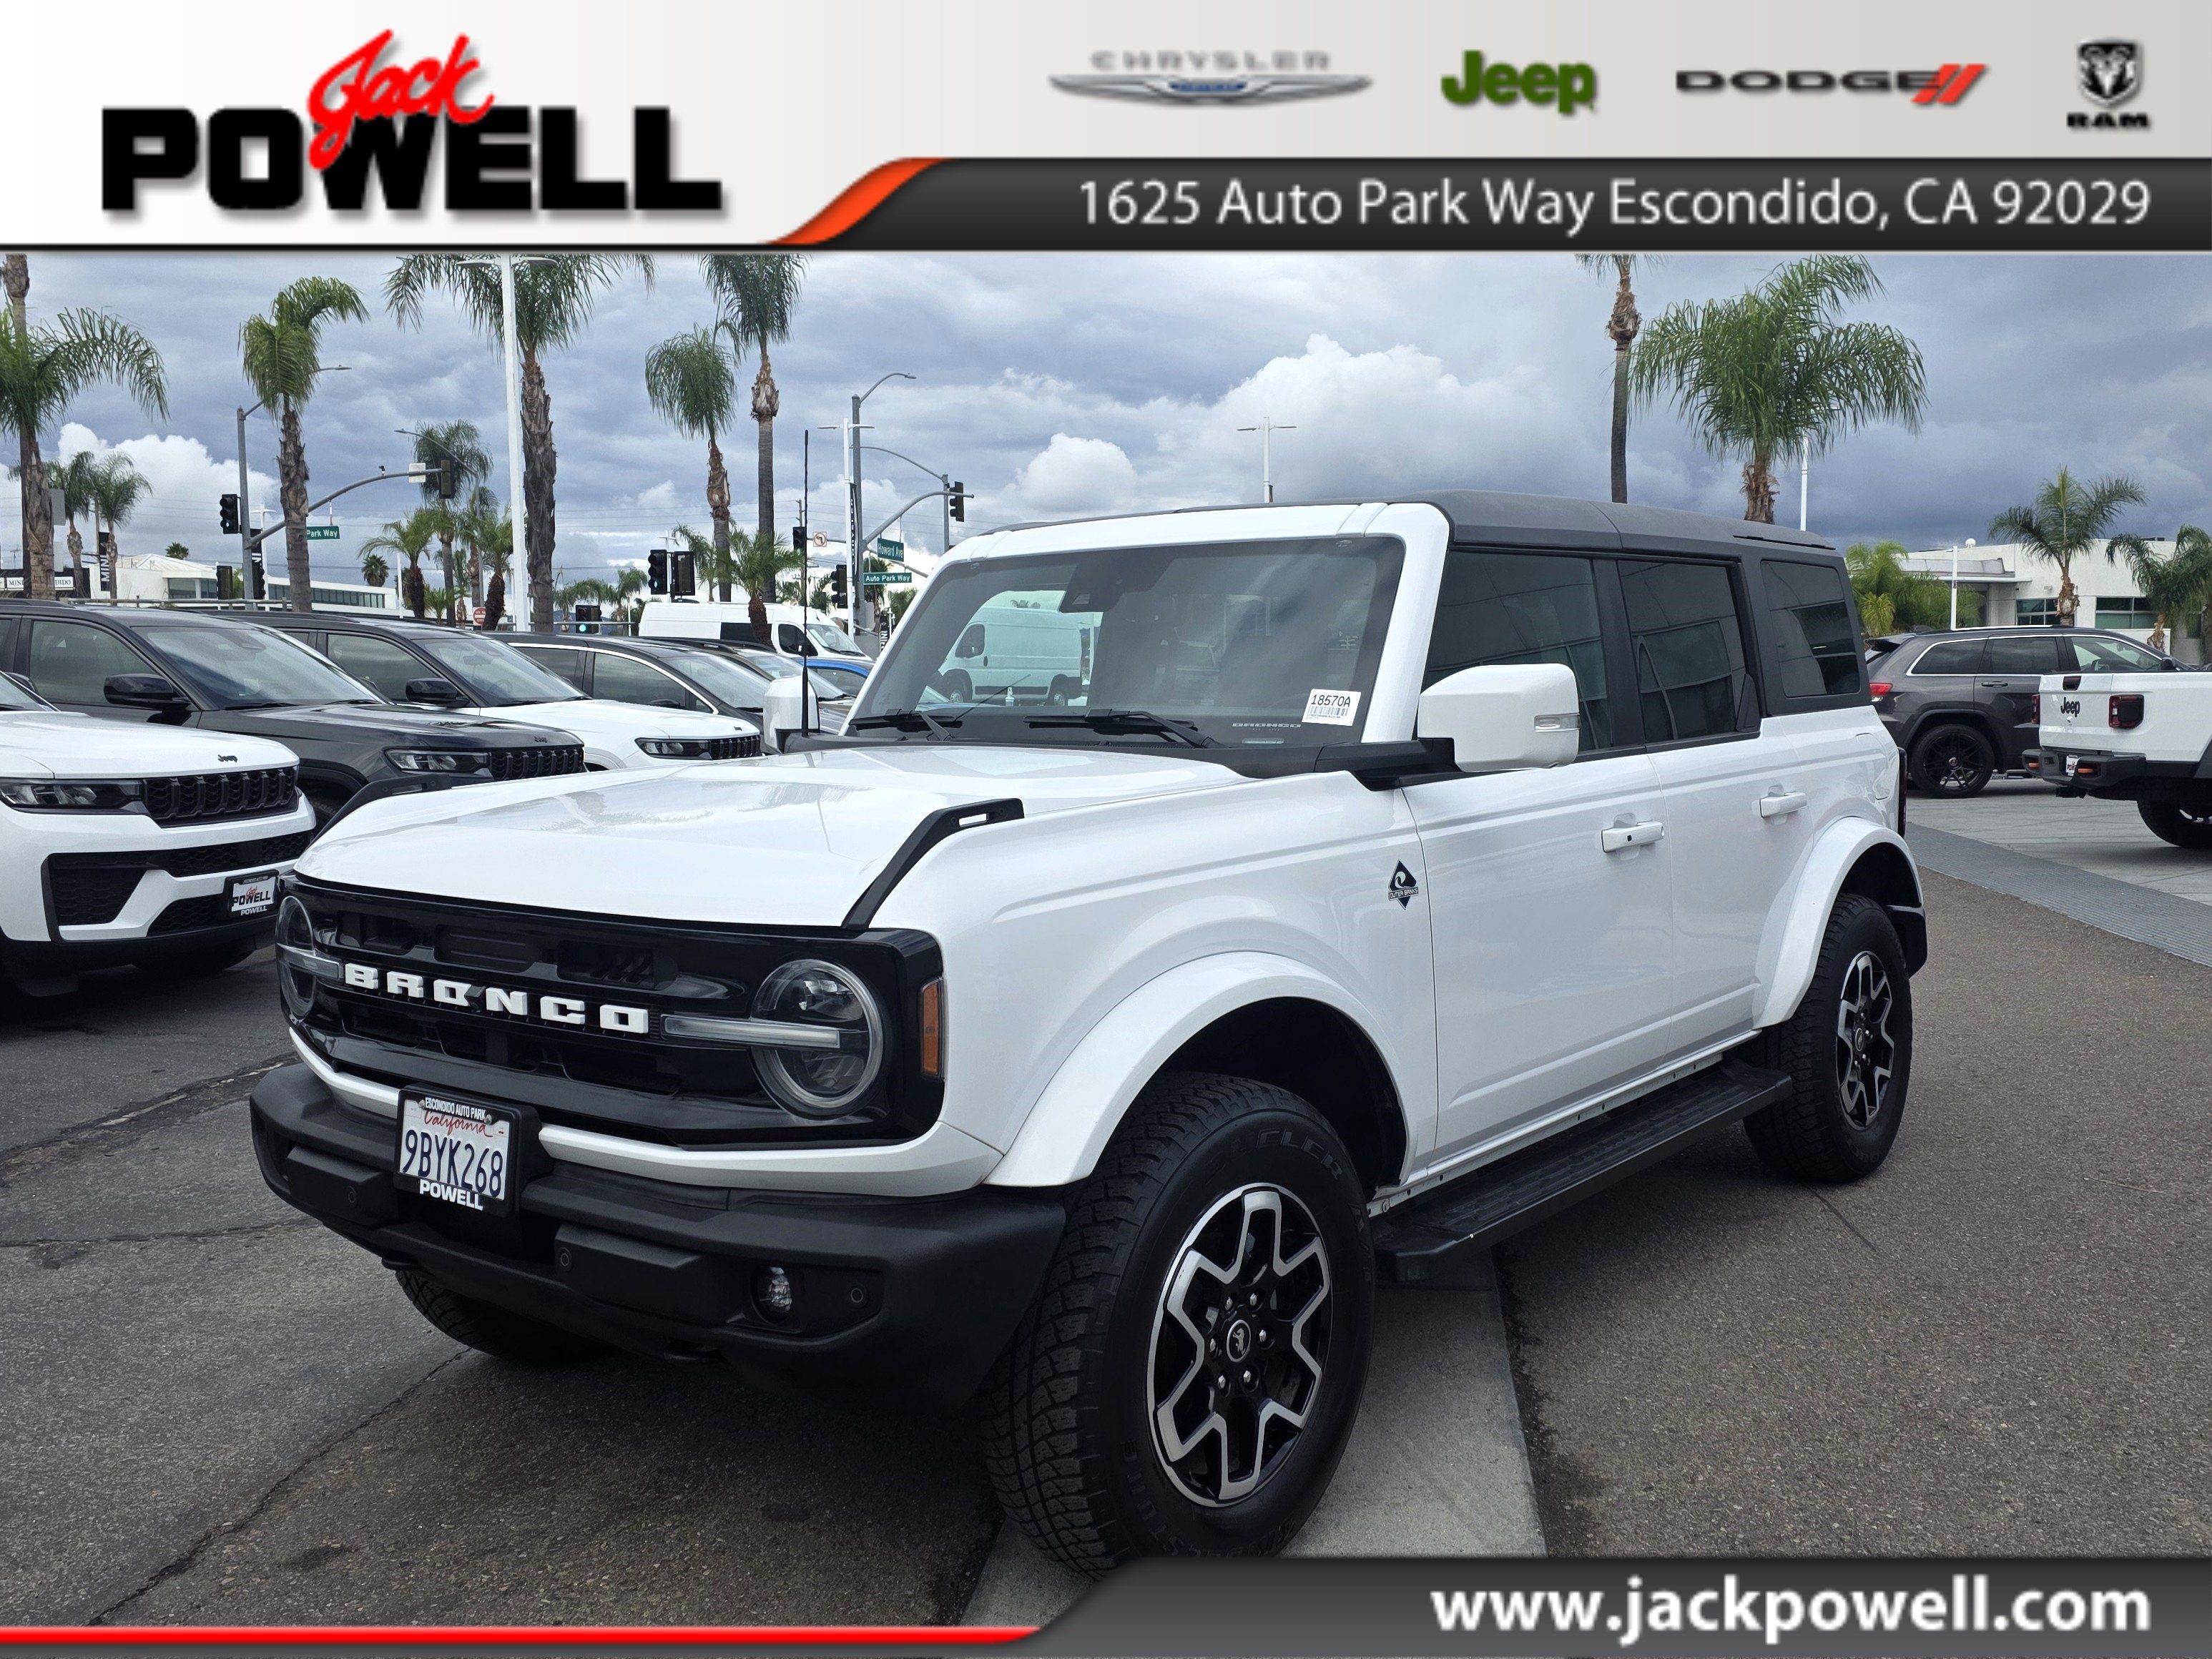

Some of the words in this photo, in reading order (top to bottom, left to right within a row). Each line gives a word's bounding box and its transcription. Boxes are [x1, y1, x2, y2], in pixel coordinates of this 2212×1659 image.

[323, 529, 338, 538] Way
[878, 543, 895, 556] Howard
[1311, 694, 1351, 707] 18570A
[2060, 696, 2080, 717] Jeep
[232, 890, 271, 907] POWELL
[240, 905, 267, 915] POWELL
[345, 963, 649, 1034] BRONCO
[425, 1097, 455, 1114] ESCONDIDO
[456, 1103, 470, 1118] AUTO
[471, 1108, 486, 1121] PARK
[424, 1110, 493, 1138] California
[402, 1129, 503, 1198] 9BYK268
[419, 1178, 483, 1211] POWELL
